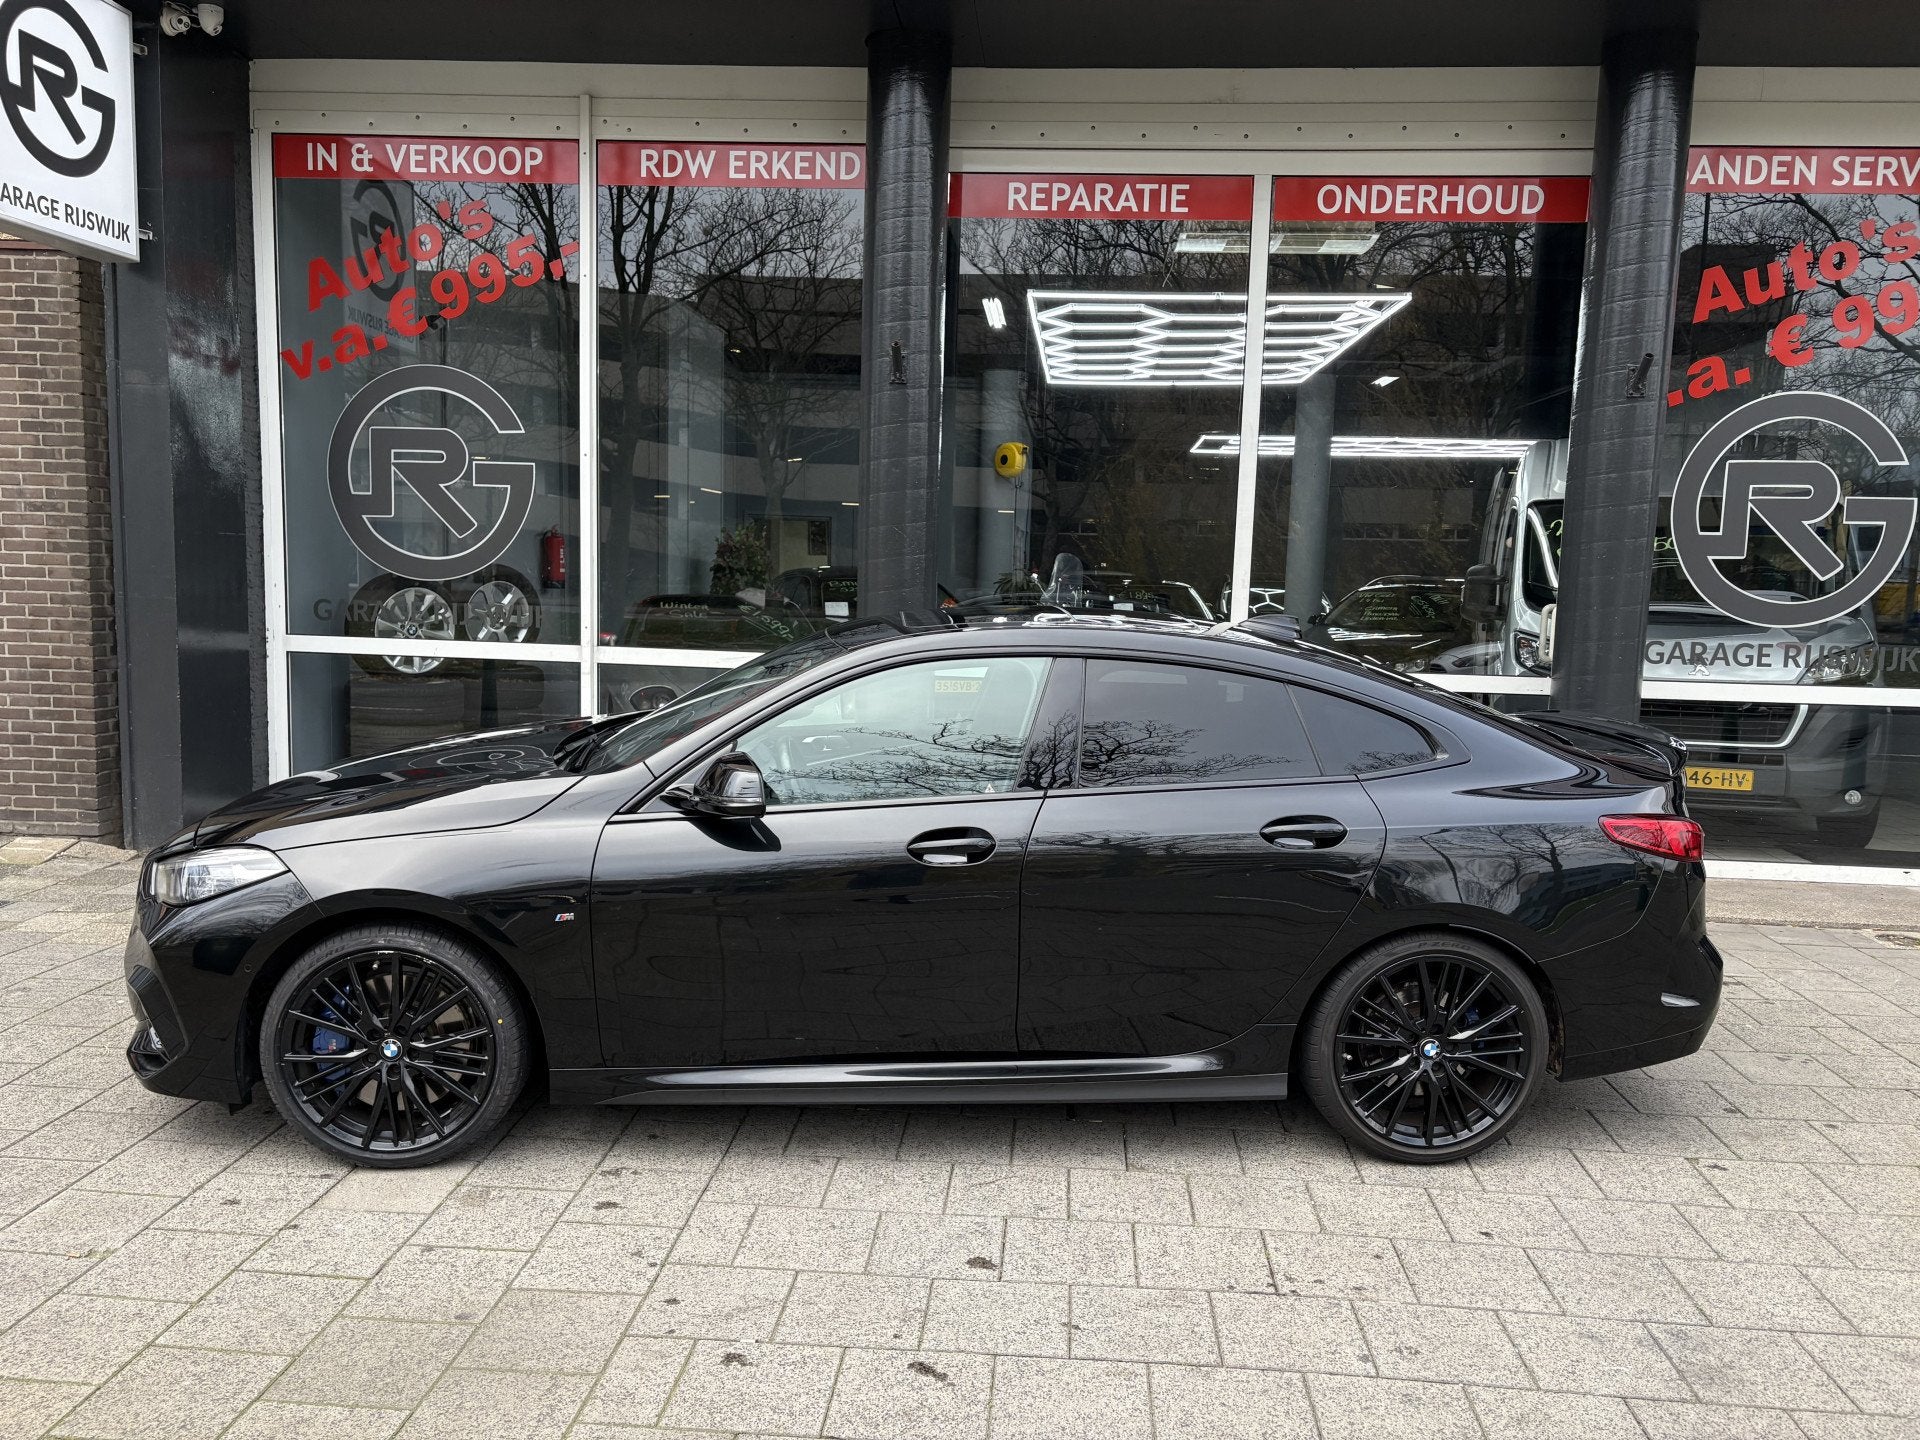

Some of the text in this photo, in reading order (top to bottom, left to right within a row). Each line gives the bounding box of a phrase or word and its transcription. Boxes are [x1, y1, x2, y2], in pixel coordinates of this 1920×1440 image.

[306, 142, 544, 176] IN & VERKOOP
[640, 149, 861, 181] RDW ERKEND
[1686, 154, 1920, 187] ANDEN SERV
[0, 182, 131, 243] ARAGE RIJSWIJK
[1007, 181, 1190, 213] REPARATIE
[1316, 184, 1545, 215] ONDERHOUD
[308, 200, 494, 313] Auto's
[1693, 218, 1920, 324] Auto's
[1667, 355, 1752, 408] .a.
[1644, 640, 1920, 674] GARAGE RIJSWIJK
[1688, 770, 1747, 788] 46-HV
